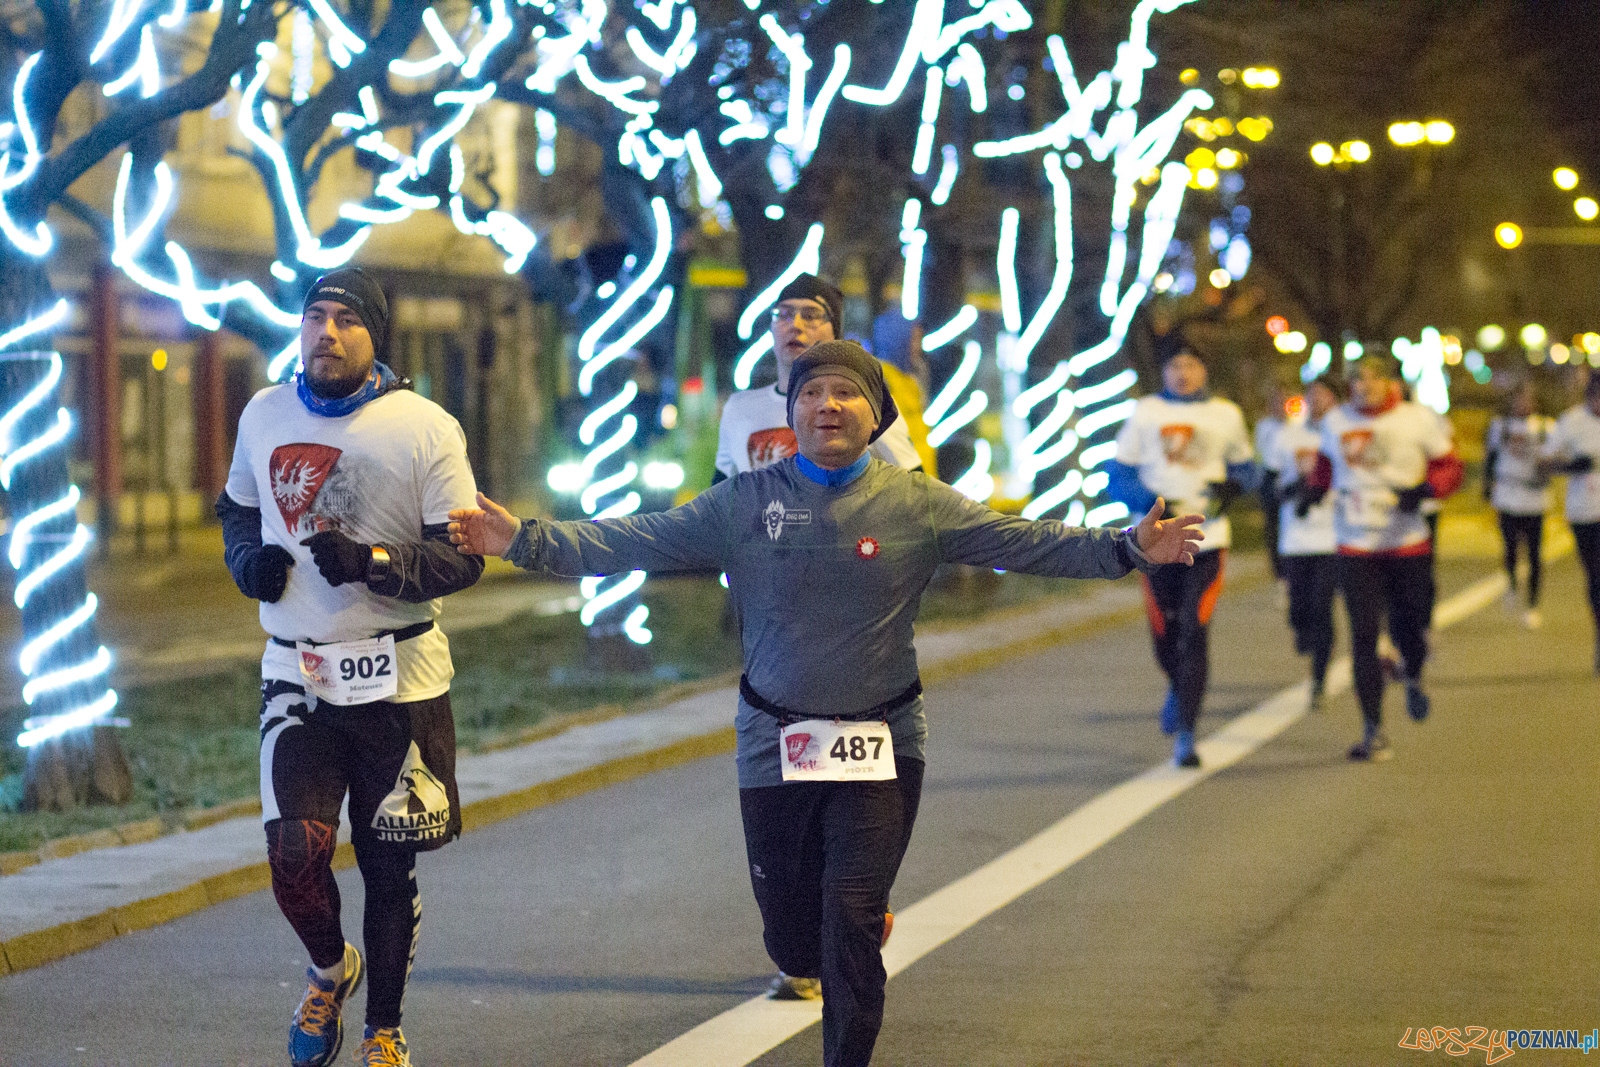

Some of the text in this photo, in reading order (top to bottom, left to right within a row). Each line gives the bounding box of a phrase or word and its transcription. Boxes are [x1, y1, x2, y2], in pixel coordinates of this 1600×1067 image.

[340, 654, 392, 681] 902
[830, 736, 885, 762] 487
[845, 766, 875, 774] PIOTR
